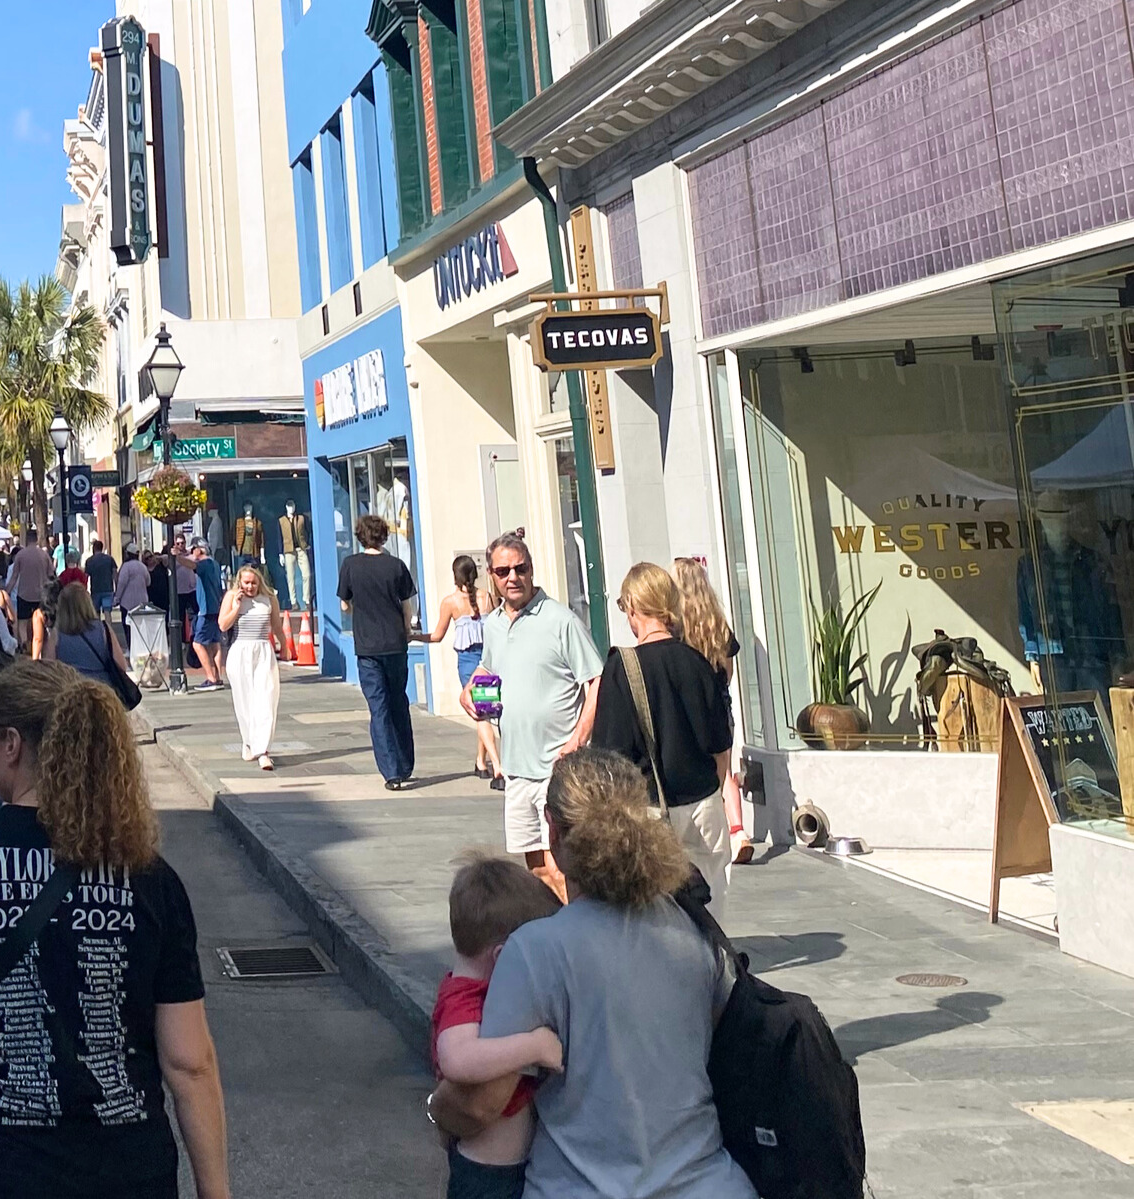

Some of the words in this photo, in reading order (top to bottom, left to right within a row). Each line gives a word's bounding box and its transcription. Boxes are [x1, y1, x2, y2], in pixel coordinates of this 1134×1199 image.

[122, 30, 140, 44] 294
[126, 51, 138, 65] M.
[126, 72, 145, 213] DUMAS
[546, 327, 650, 350] TECOVAS
[174, 438, 220, 458] Society
[223, 438, 233, 450] St
[880, 493, 987, 515] QUALITY
[898, 562, 981, 580] GOODS
[1026, 706, 1094, 736] WANTED
[20, 881, 74, 904] ERS
[77, 885, 135, 907] TOUR
[71, 908, 137, 933] 2024
